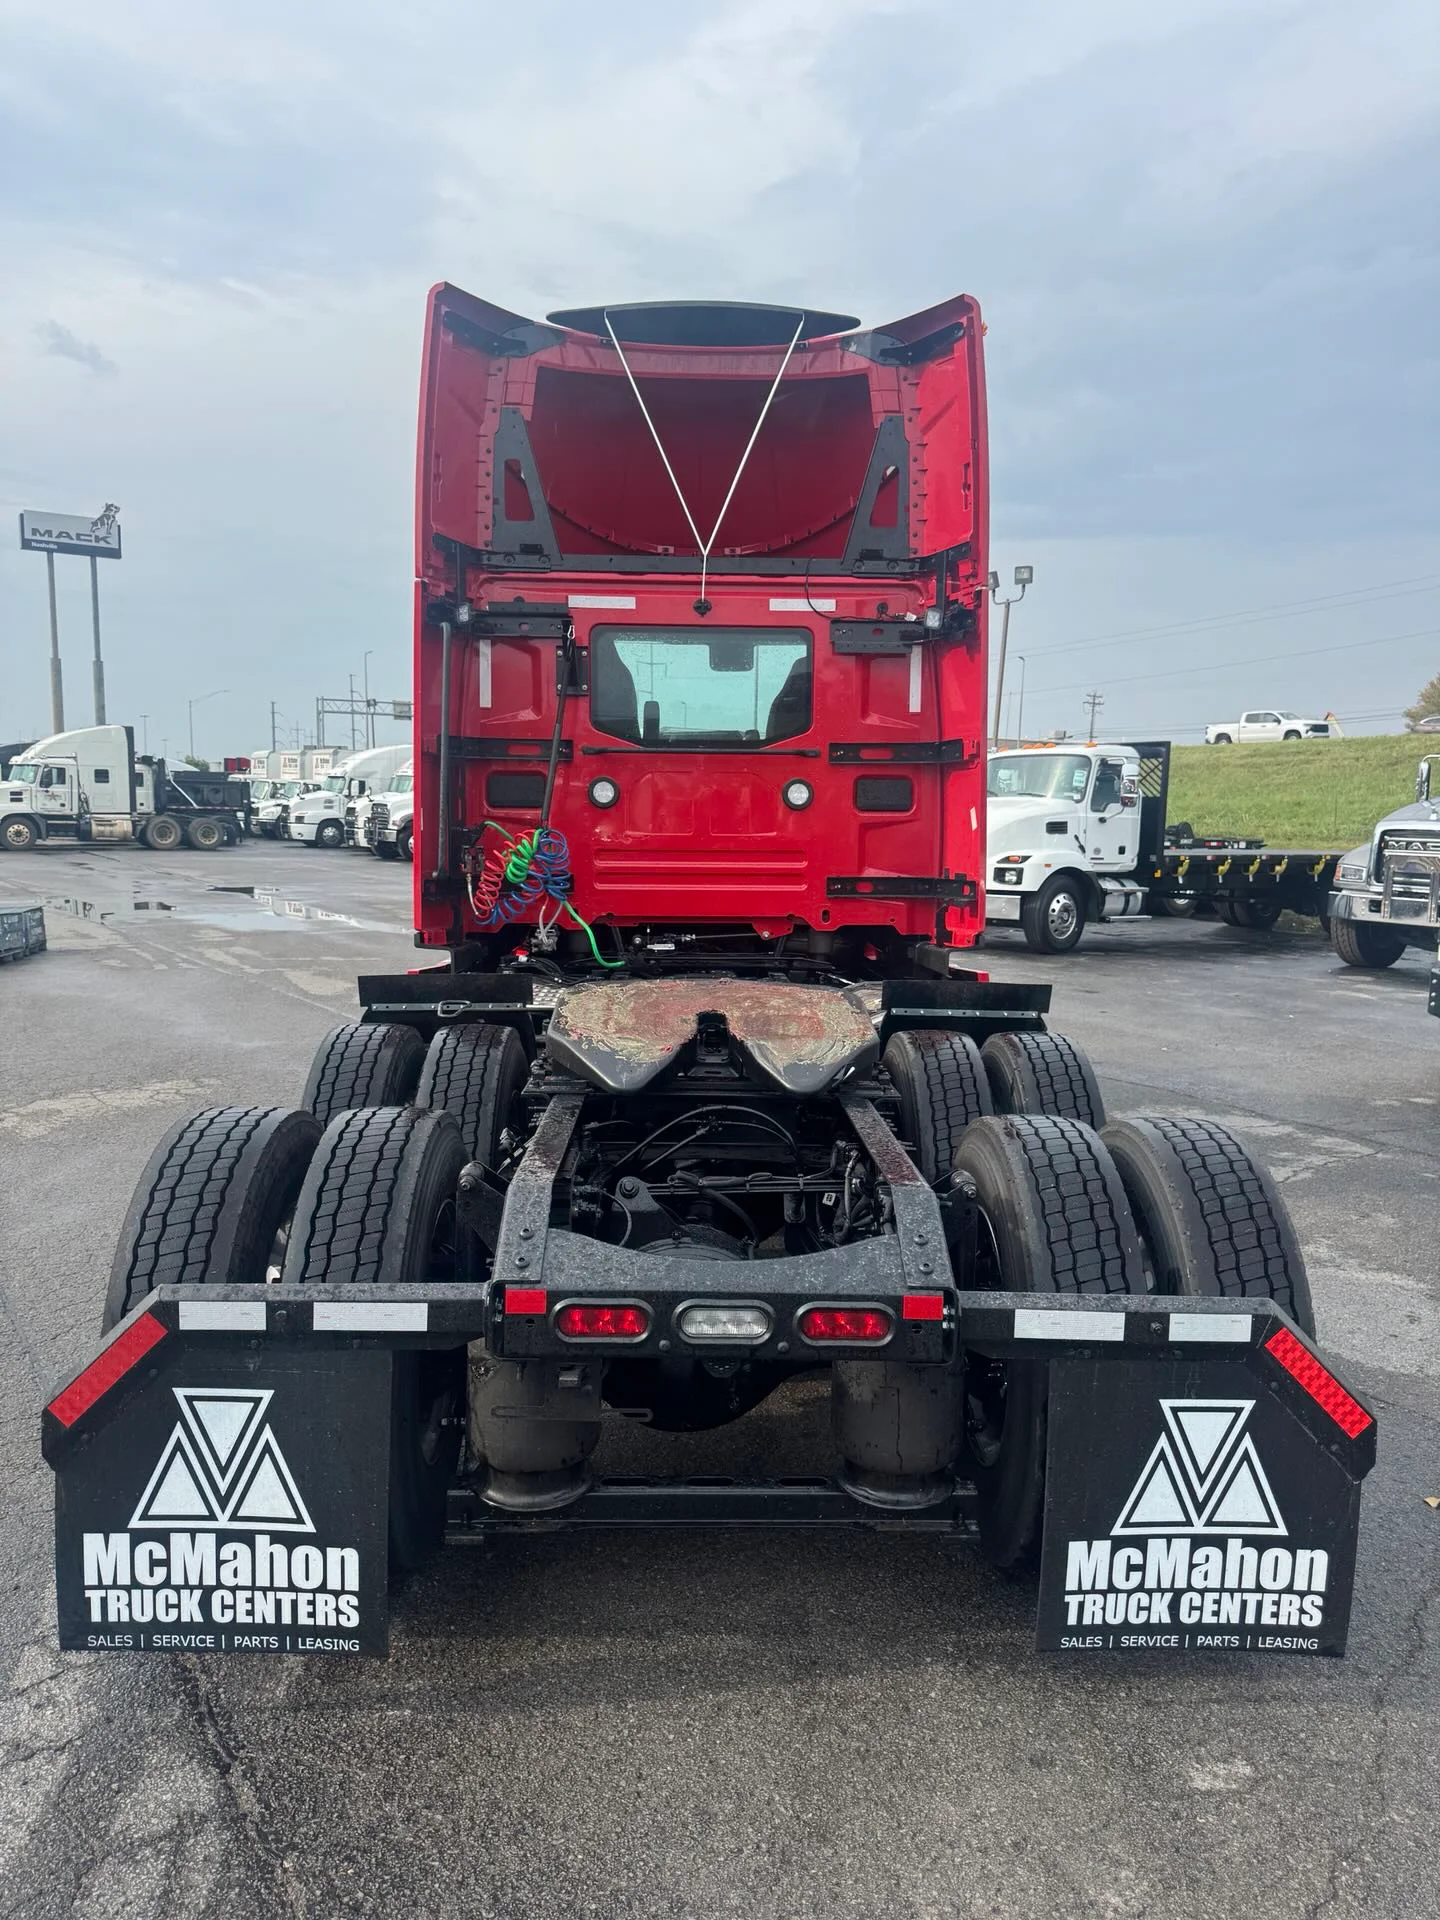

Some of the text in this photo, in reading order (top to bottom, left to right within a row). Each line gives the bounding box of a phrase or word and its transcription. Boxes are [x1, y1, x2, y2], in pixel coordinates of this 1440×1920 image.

[31, 527, 112, 544] MACK
[83, 1532, 360, 1591] McMahon
[1065, 1538, 1329, 1592] McMahon
[84, 1588, 360, 1628] TRUCK CENTERS
[1064, 1591, 1324, 1627] TRUCK CENTERS
[87, 1635, 360, 1651] SALES SERVICE PARTS LEASING
[1060, 1635, 1319, 1649] SALES SERVICE PARTS LEASING
